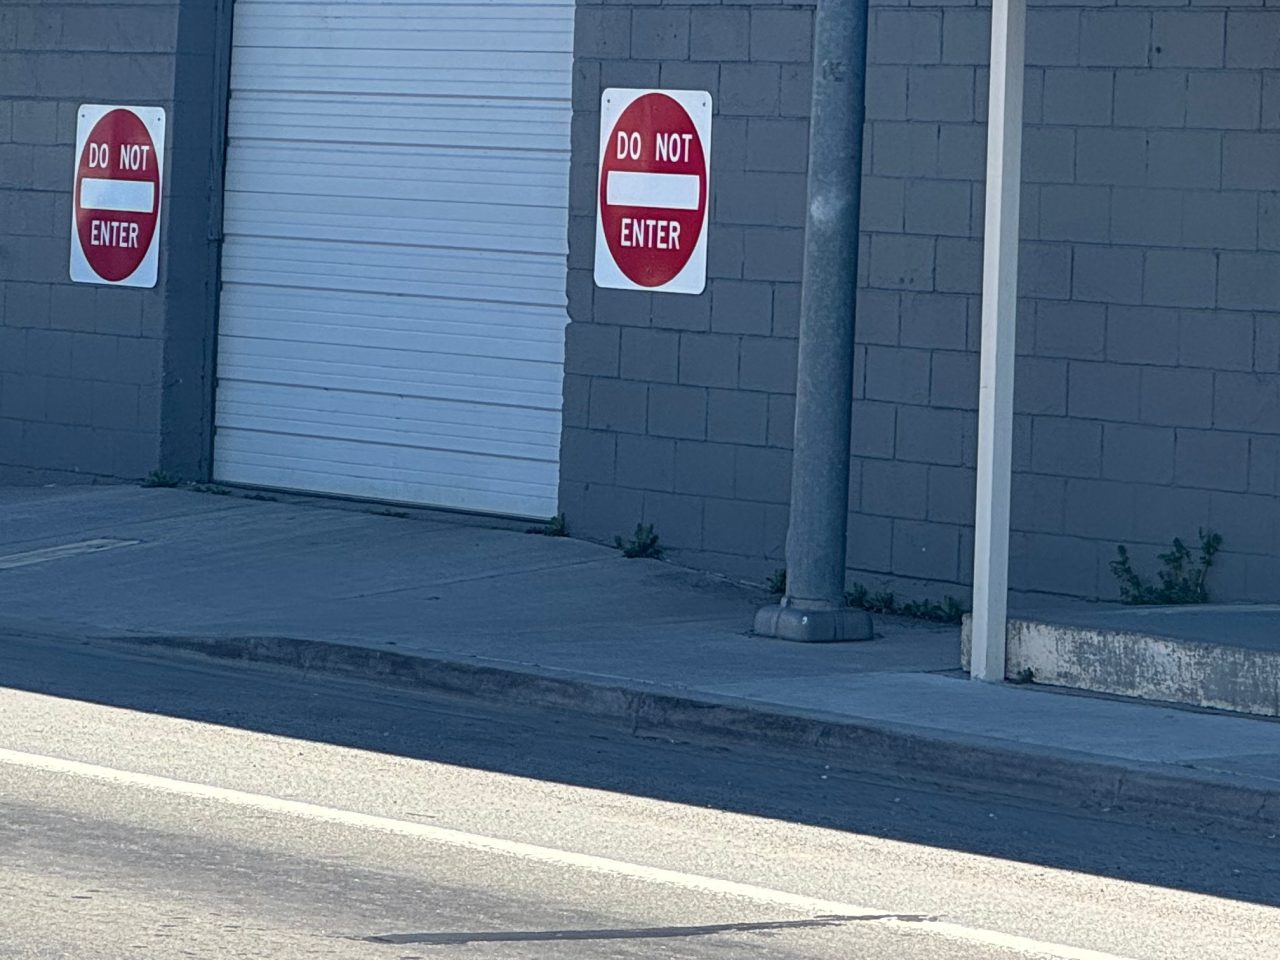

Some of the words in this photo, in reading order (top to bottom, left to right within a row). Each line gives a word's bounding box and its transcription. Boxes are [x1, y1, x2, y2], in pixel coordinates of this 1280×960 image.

[88, 142, 109, 169] DO
[119, 144, 150, 171] NOT
[616, 131, 642, 160] DO
[655, 133, 693, 163] NOT
[90, 220, 139, 249] ENTER
[620, 218, 681, 250] ENTER
